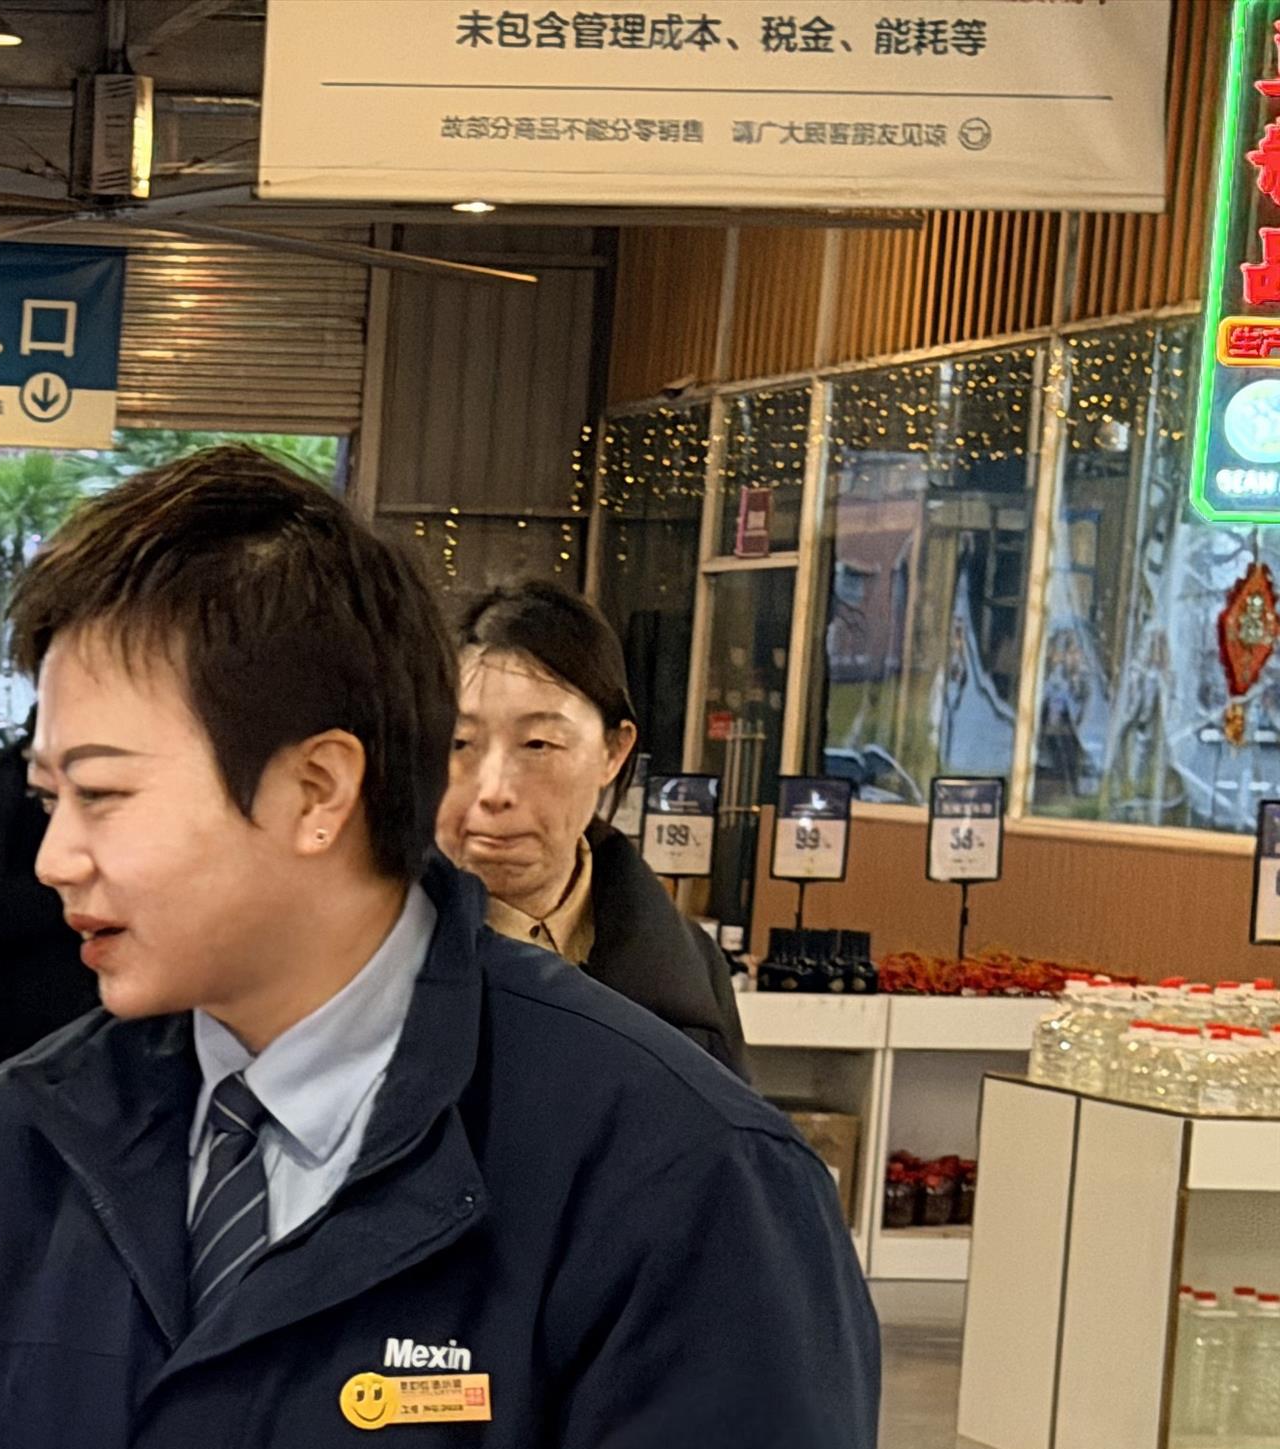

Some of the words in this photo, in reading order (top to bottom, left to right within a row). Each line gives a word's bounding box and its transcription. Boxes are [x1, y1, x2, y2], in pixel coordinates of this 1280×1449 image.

[455, 10, 988, 56] 未包含管理成本、税金、能耗等
[384, 1338, 471, 1371] Mexin
